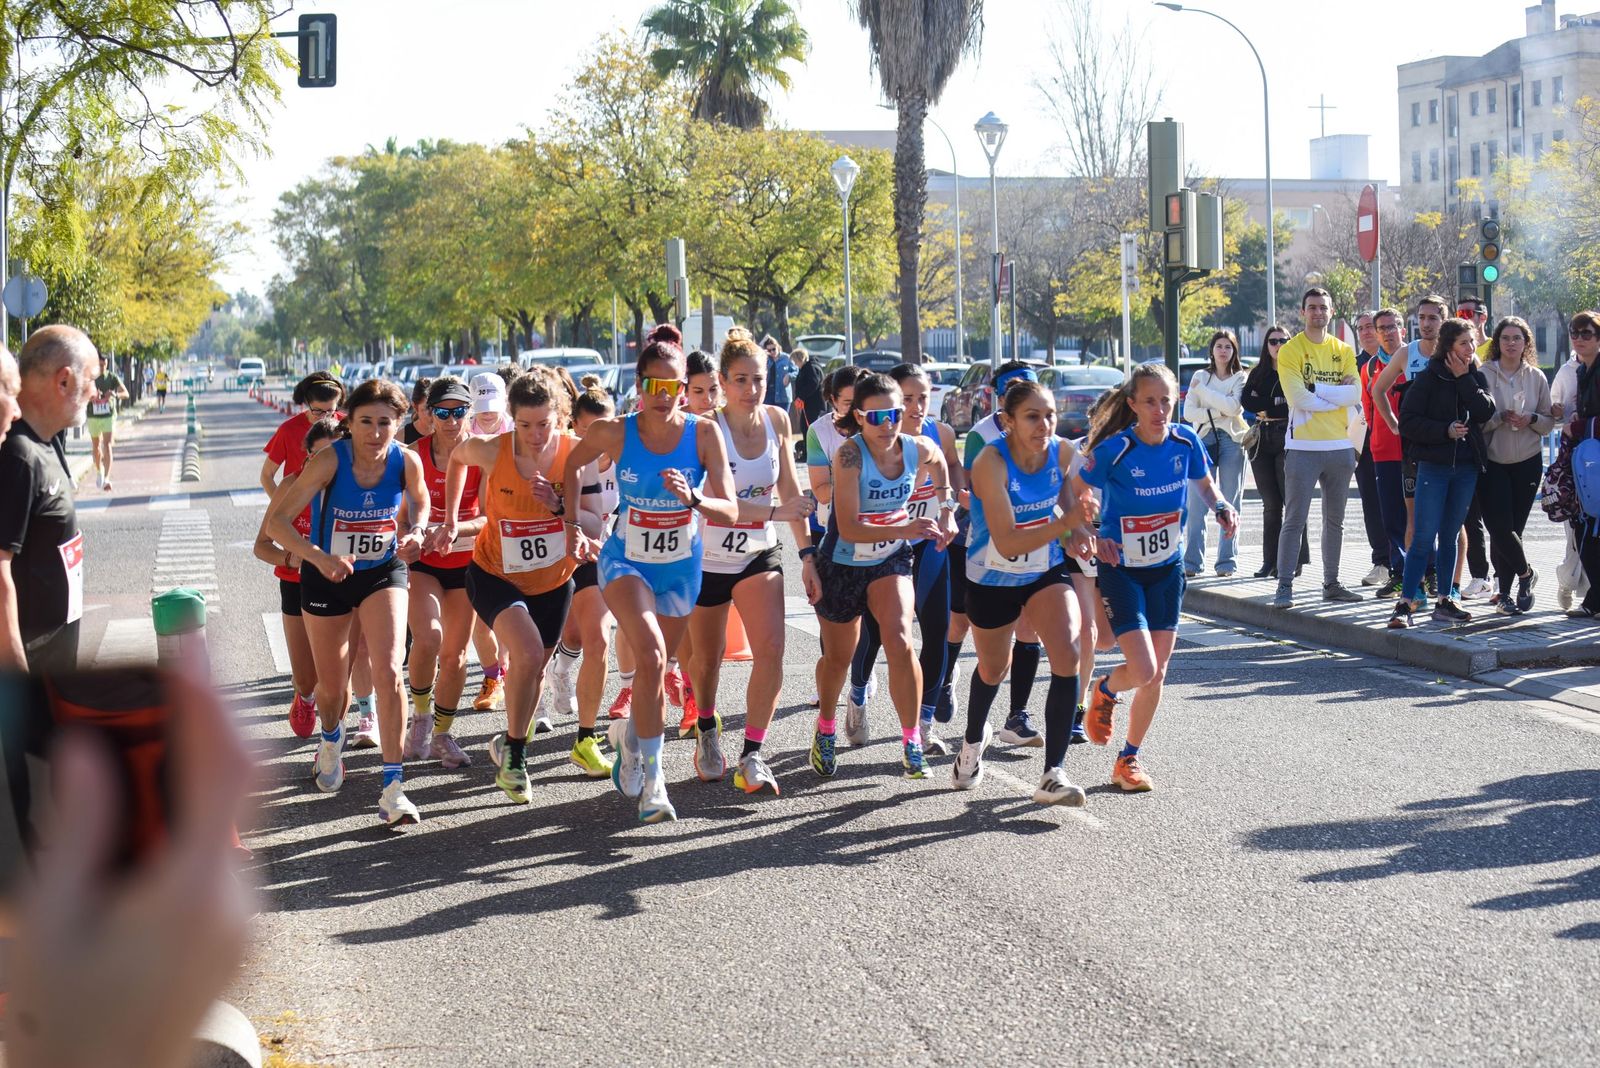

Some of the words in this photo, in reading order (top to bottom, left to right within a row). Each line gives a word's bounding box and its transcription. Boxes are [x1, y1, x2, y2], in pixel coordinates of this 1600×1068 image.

[868, 483, 911, 500] nerja
[347, 534, 384, 554] 156
[520, 537, 548, 561] 86
[641, 530, 679, 553] 145
[721, 531, 749, 553] 42
[1137, 529, 1170, 557] 189
